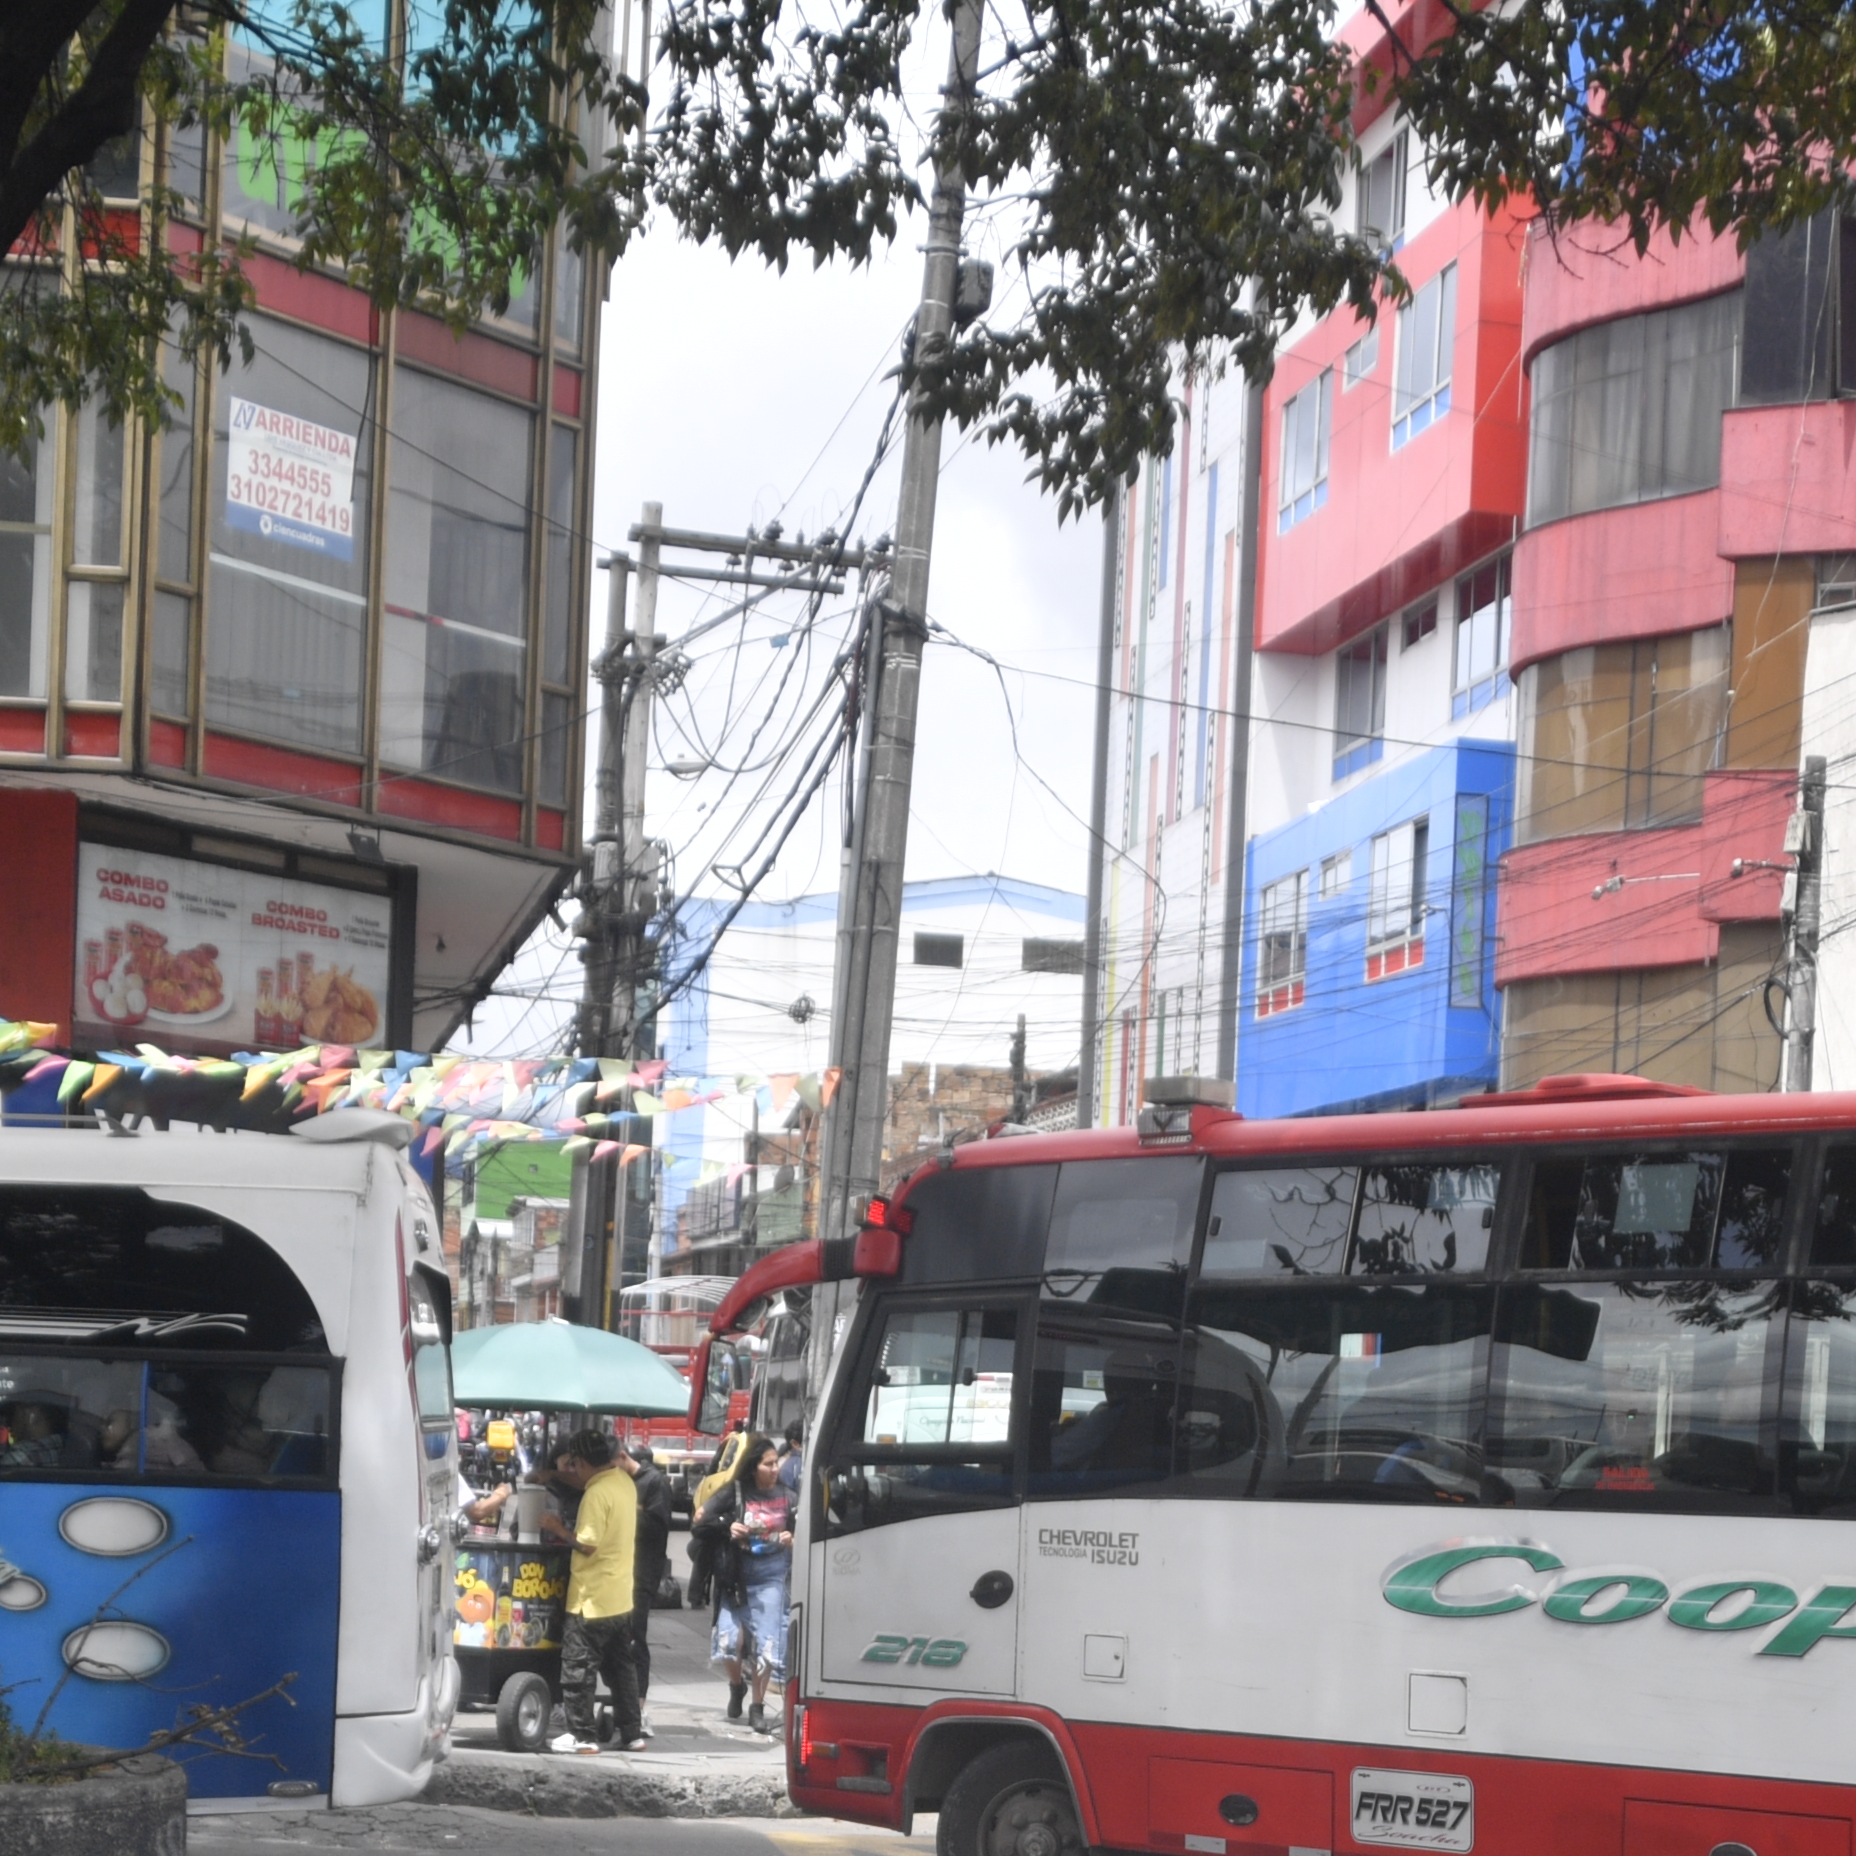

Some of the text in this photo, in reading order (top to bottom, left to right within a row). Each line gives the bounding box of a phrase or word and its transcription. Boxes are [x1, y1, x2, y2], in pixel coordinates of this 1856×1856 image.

[255, 408, 352, 458] ARRIENDA
[248, 448, 332, 498] 3344555
[230, 473, 350, 533] 3102721419
[272, 522, 326, 547] ciencuadras
[96, 867, 169, 893] COMBO
[99, 886, 166, 910] ASADO
[266, 900, 328, 922] COMBO
[251, 912, 341, 939] BROASTED
[1038, 1528, 1140, 1550] CHEVROLET
[1038, 1545, 1088, 1559] TECNOLOGIA
[519, 1562, 546, 1580] DON
[859, 1633, 970, 1668] 218
[1354, 1791, 1470, 1831] FRR 527
